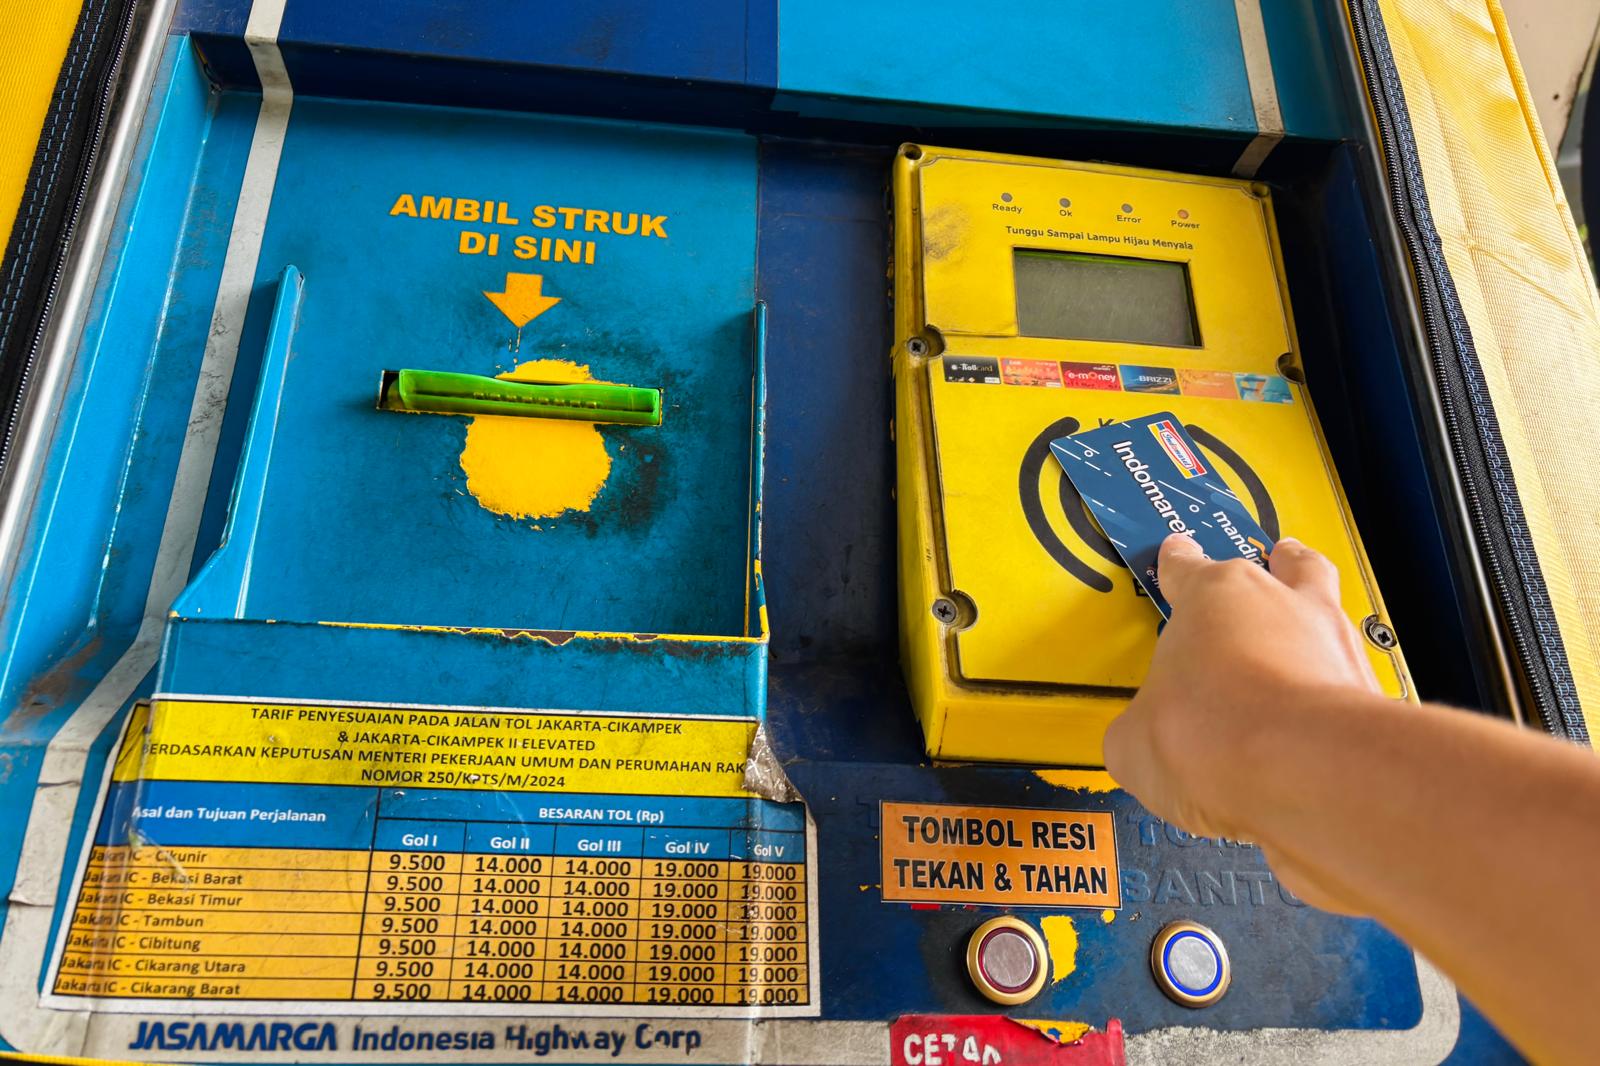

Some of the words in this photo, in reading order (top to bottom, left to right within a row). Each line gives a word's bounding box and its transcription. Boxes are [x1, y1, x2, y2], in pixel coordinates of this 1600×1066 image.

[389, 194, 519, 225] AMBIL
[531, 205, 669, 238] STRUK
[992, 203, 1023, 214] Ready
[1059, 209, 1073, 217] Ok
[1117, 214, 1142, 224] Error
[1171, 220, 1201, 229] Power
[458, 231, 500, 256] DI
[513, 235, 596, 264] SINI
[1006, 226, 1044, 237] Tunggu
[1047, 228, 1084, 241] Sampai
[1087, 233, 1121, 244] Lampu
[1124, 236, 1150, 247] Hijau
[1152, 239, 1193, 250] Menyala
[252, 708, 294, 721] TARIF
[298, 710, 404, 725] PENYESUAIAN
[409, 714, 450, 727] PADA
[454, 716, 500, 729] JALAN
[505, 718, 533, 730] TOL
[536, 720, 682, 735] JAKARTA-CIKAMPEK
[338, 731, 349, 742] &
[353, 732, 503, 748] JAKARTA-CIKAMPEK
[508, 738, 517, 749] II
[521, 739, 595, 751] ELEVATED
[261, 747, 353, 761] KEPUTUSAN
[358, 751, 427, 764] MENTERI
[431, 753, 517, 767] PEKERJAAN
[521, 757, 574, 769] UMUM
[579, 758, 611, 770] DAN
[616, 760, 712, 773] PERUMAHAN
[361, 769, 423, 783] NOMOR
[428, 771, 566, 788] 250/KPTS/M/2024
[132, 806, 163, 819] Asal
[165, 807, 193, 819] dan
[197, 807, 246, 822] Tujuan
[250, 809, 326, 823] Perjalanan
[539, 807, 603, 820] BESARAN
[607, 809, 632, 821] TOL
[636, 809, 665, 824] (Rp)
[402, 834, 431, 847] Gol
[433, 835, 438, 847] I
[490, 837, 516, 849] Gol
[520, 838, 530, 850] II
[577, 839, 605, 852] Gol
[607, 840, 621, 852] III
[665, 841, 690, 854] Gol
[694, 842, 710, 855] IV
[754, 844, 772, 857] Gol
[774, 846, 784, 857] V
[902, 815, 1023, 848] TOMBOL
[1032, 821, 1096, 852] RESI
[155, 850, 207, 863] Cikunir
[389, 854, 446, 871] 9.500
[475, 857, 542, 874] 14.000
[566, 860, 631, 877] 14.000
[655, 862, 719, 879] 19.000
[742, 865, 796, 881] 19.000
[894, 859, 984, 892] TEKAN
[994, 863, 1012, 892] &
[1020, 864, 1108, 895] TAHAN
[152, 872, 199, 884] Bekasi
[203, 873, 243, 885] Barat
[387, 875, 443, 892] 9.500
[473, 878, 541, 895] 14.000
[564, 881, 630, 897] 14.000
[654, 882, 718, 899] 19.000
[742, 884, 797, 901] 19.000
[120, 892, 134, 904] IC
[147, 893, 196, 905] Bekasi
[200, 894, 243, 907] Timur
[384, 896, 441, 913] 9.500
[471, 898, 539, 915] 14.000
[562, 901, 629, 917] 14.000
[652, 903, 718, 919] 19.000
[741, 905, 797, 921] 19.000
[117, 914, 130, 925] IC
[144, 915, 204, 927] Tambun
[381, 917, 439, 934] 9.500
[469, 919, 537, 936] 14.000
[561, 922, 627, 938] 14.000
[651, 924, 717, 940] 19.000
[740, 926, 798, 942] 19.000
[111, 936, 126, 949] IC
[139, 936, 201, 952] Cibitung
[379, 939, 436, 956] 9.500
[467, 940, 535, 958] 14.000
[559, 942, 626, 959] 14.000
[650, 944, 716, 961] 19.000
[739, 947, 798, 963] 19.000
[107, 959, 122, 971] IC
[135, 959, 199, 975] Cikarang
[204, 961, 246, 973] Utara
[376, 961, 434, 978] 9.500
[464, 962, 533, 979] 14.000
[557, 964, 625, 981] 14.000
[649, 966, 715, 983] 19.000
[738, 967, 798, 983] 19.000
[104, 981, 117, 993] IC
[131, 981, 195, 997] Cikarang
[200, 983, 241, 995] Barat
[373, 983, 431, 1000] 9.500
[462, 984, 532, 1001] 14.000
[556, 986, 624, 1002] 14.000
[648, 987, 714, 1004] 19.000
[737, 988, 799, 1004] 19.000
[128, 1022, 339, 1051] JASAMARGA
[352, 1025, 495, 1051] Indonesia
[506, 1024, 626, 1057] Highway
[635, 1023, 702, 1056] Corp
